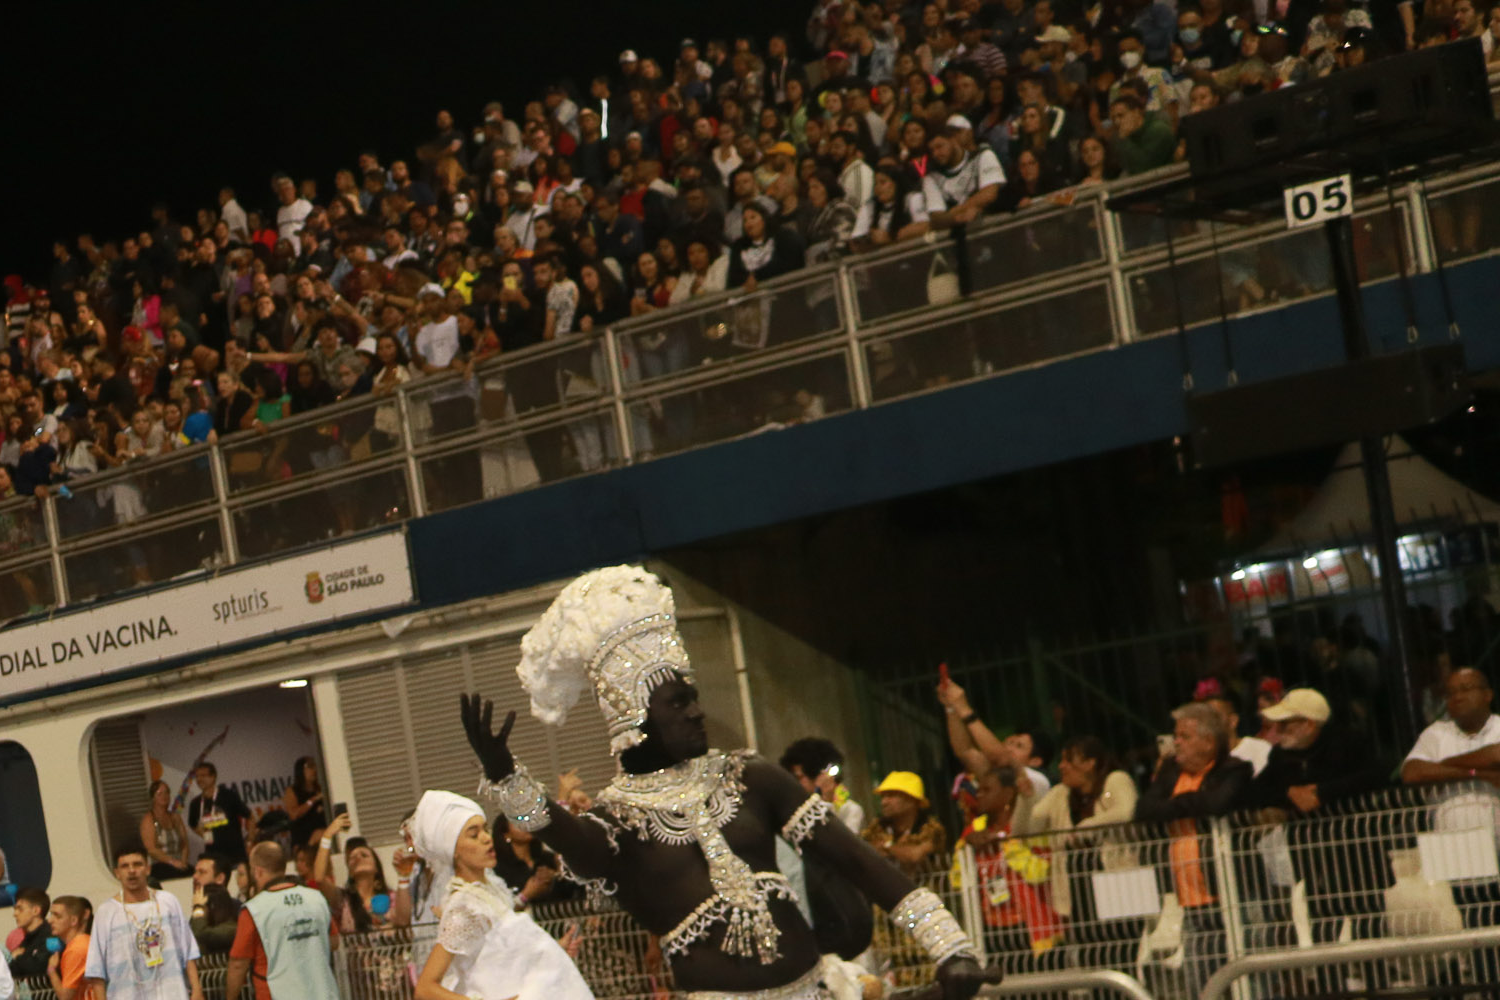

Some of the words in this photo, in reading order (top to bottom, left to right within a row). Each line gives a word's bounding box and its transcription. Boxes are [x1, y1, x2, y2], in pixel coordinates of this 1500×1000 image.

[1292, 180, 1348, 220] 05
[349, 573, 385, 591] PAULO
[212, 588, 269, 624] spturis
[51, 637, 84, 665] DA
[86, 615, 179, 655] VACINA.
